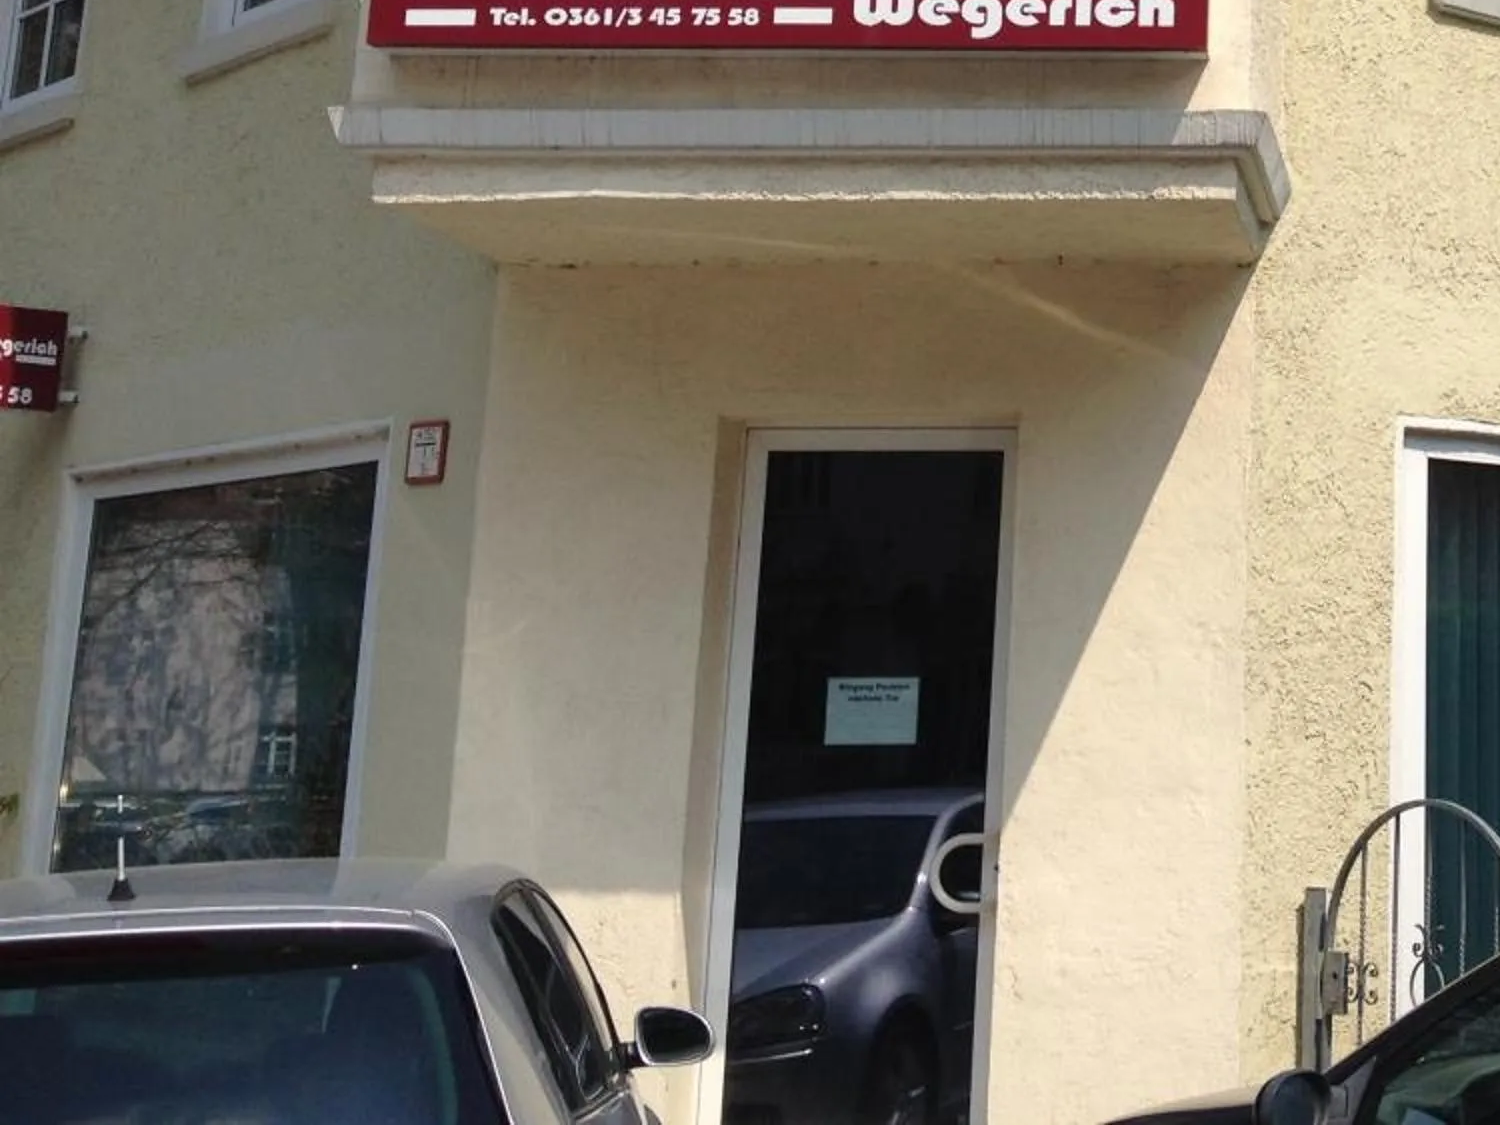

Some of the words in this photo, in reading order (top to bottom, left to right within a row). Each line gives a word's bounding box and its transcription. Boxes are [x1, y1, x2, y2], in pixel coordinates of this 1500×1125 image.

[489, 7, 537, 26] Tel.
[543, 7, 643, 28] 0361/3
[648, 7, 681, 26] 45
[691, 7, 721, 26] 75
[727, 7, 760, 26] 58
[8, 386, 33, 405] 58
